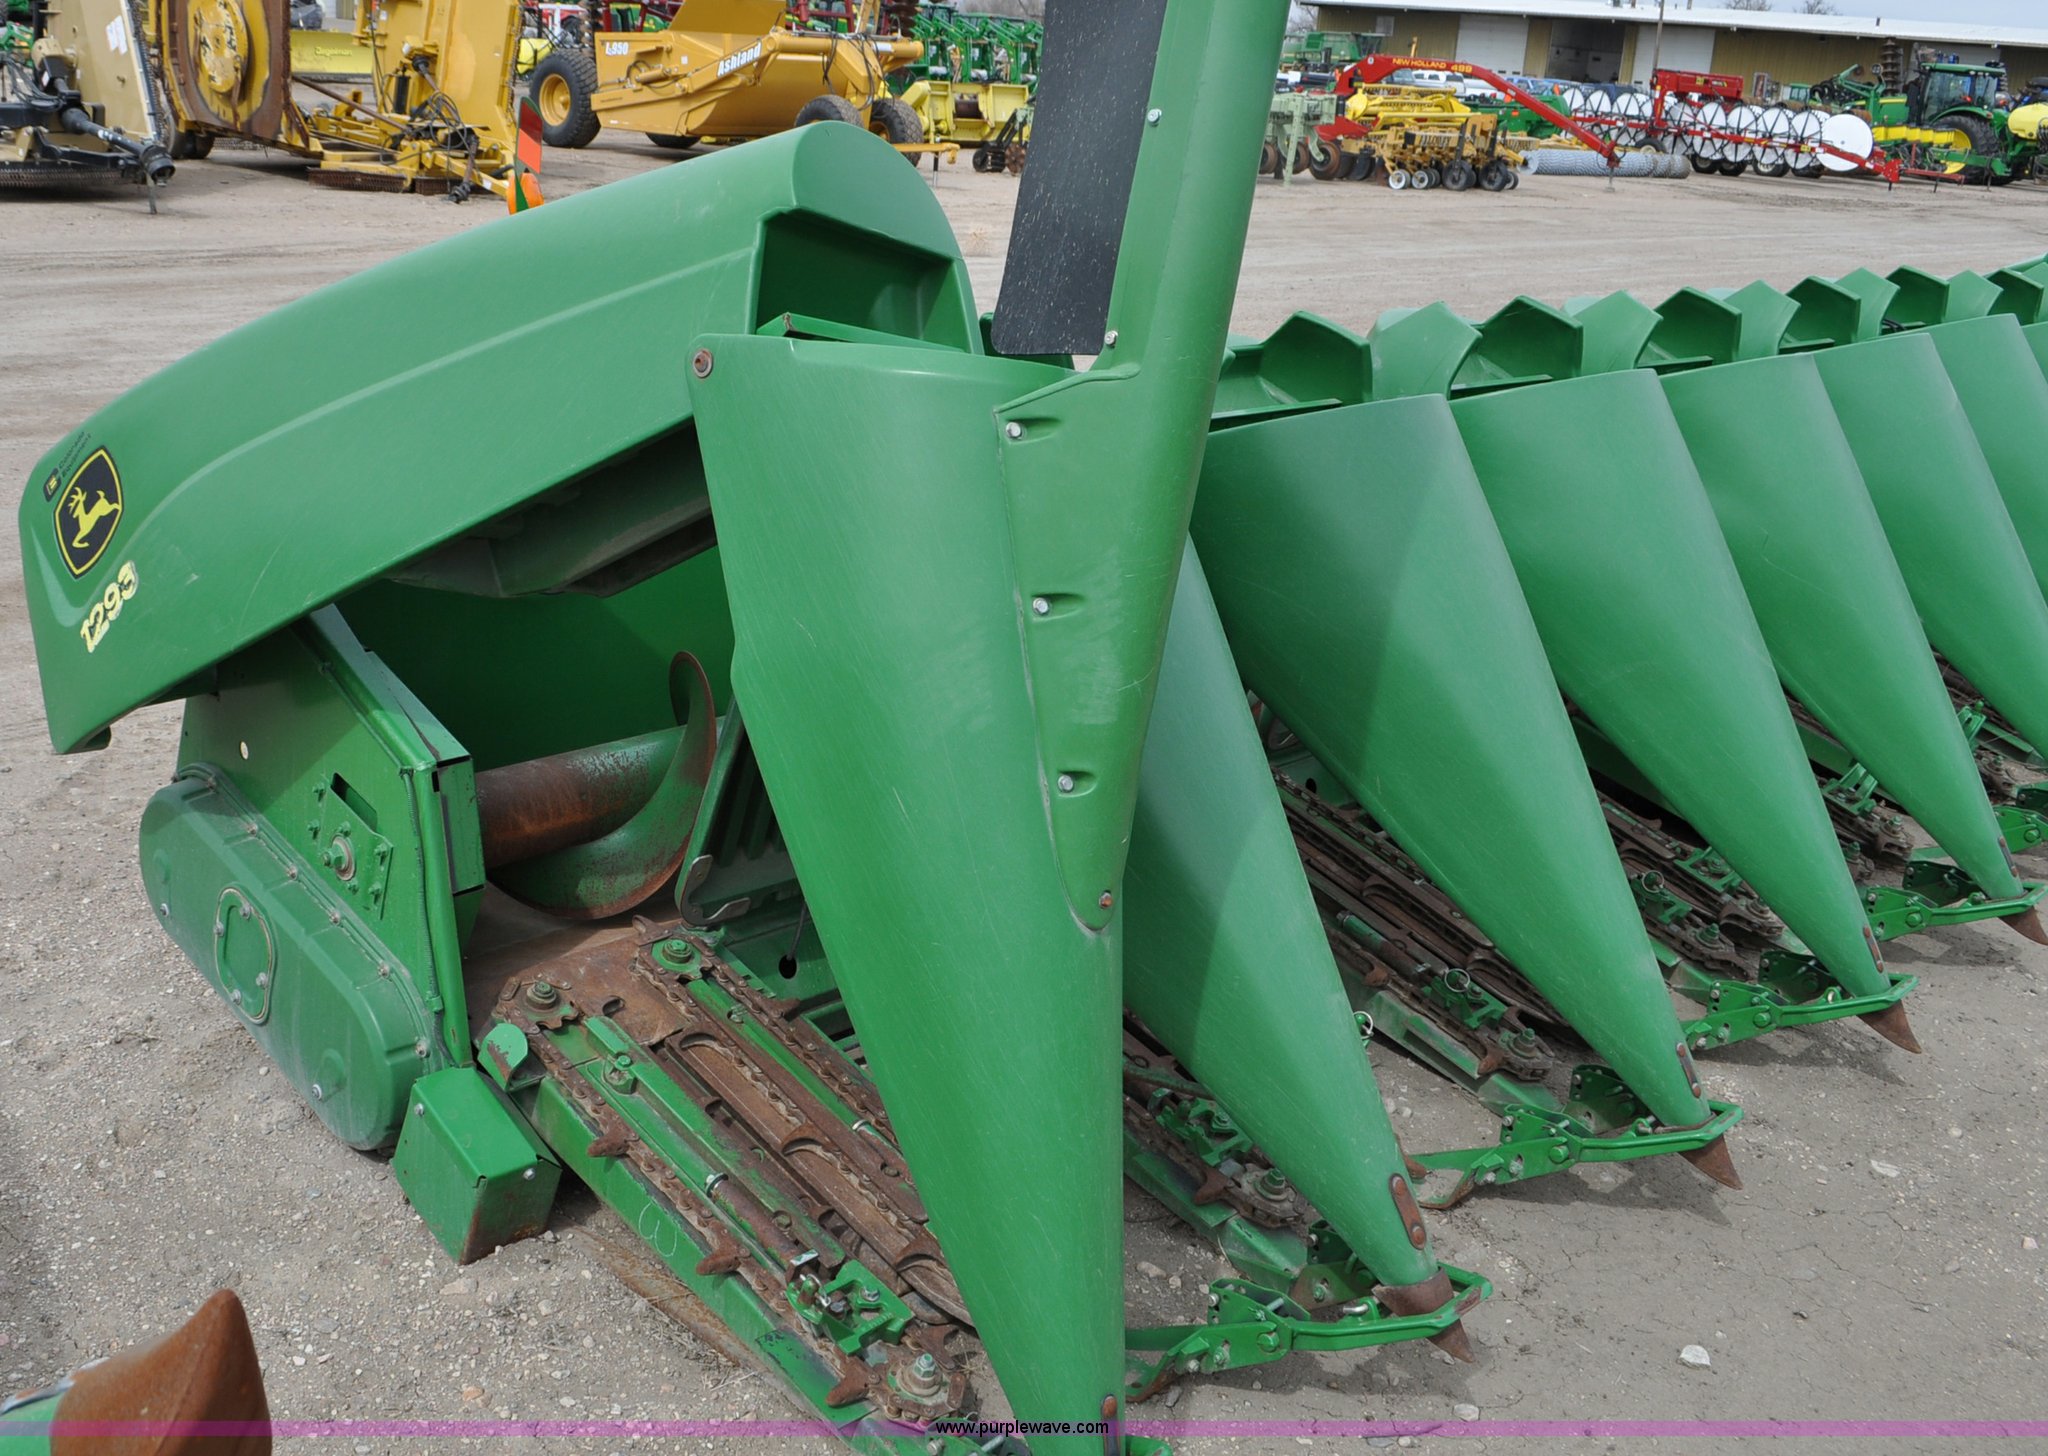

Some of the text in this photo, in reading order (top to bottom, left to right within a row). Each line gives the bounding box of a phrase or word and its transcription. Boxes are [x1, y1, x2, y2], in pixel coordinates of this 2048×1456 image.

[716, 41, 763, 79] Ashland
[1392, 57, 1410, 65] NEW
[1410, 59, 1447, 69] HOLLAND
[80, 559, 139, 653] 1293
